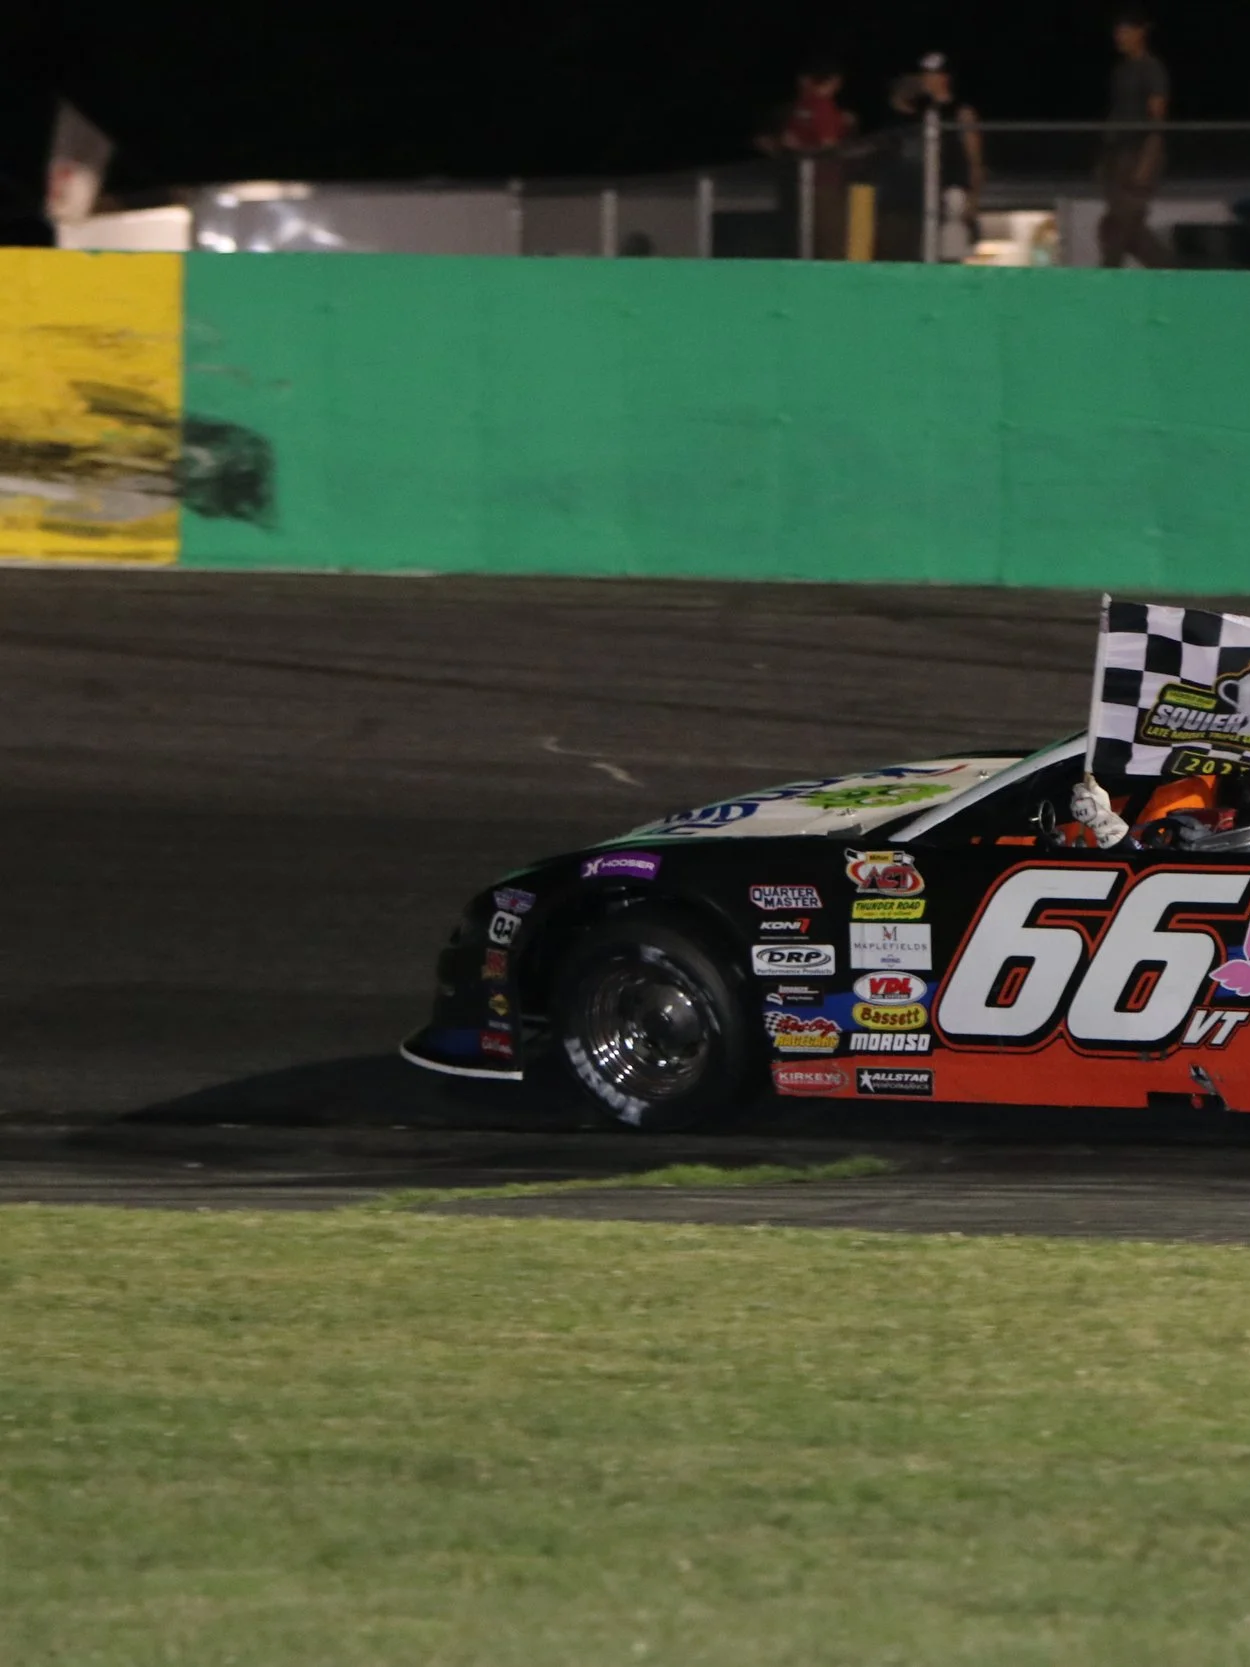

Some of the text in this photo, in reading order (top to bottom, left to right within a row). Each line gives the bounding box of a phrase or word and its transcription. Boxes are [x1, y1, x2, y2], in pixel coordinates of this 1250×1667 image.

[1152, 703, 1248, 733] SQUIER
[752, 888, 814, 902] QUARTER
[764, 897, 818, 908] MASTER
[856, 900, 921, 911] THUNDER ROAD
[760, 921, 802, 930] KONI
[854, 942, 928, 951] MAPLEFIELDS
[767, 951, 822, 963] DRP
[869, 977, 913, 995] VDL
[860, 1006, 920, 1026] Bassett
[1182, 1009, 1250, 1046] VT
[849, 1032, 932, 1052] MOROSO
[779, 1072, 833, 1081] KIRKEY
[871, 1072, 930, 1083] ALLSTAR
